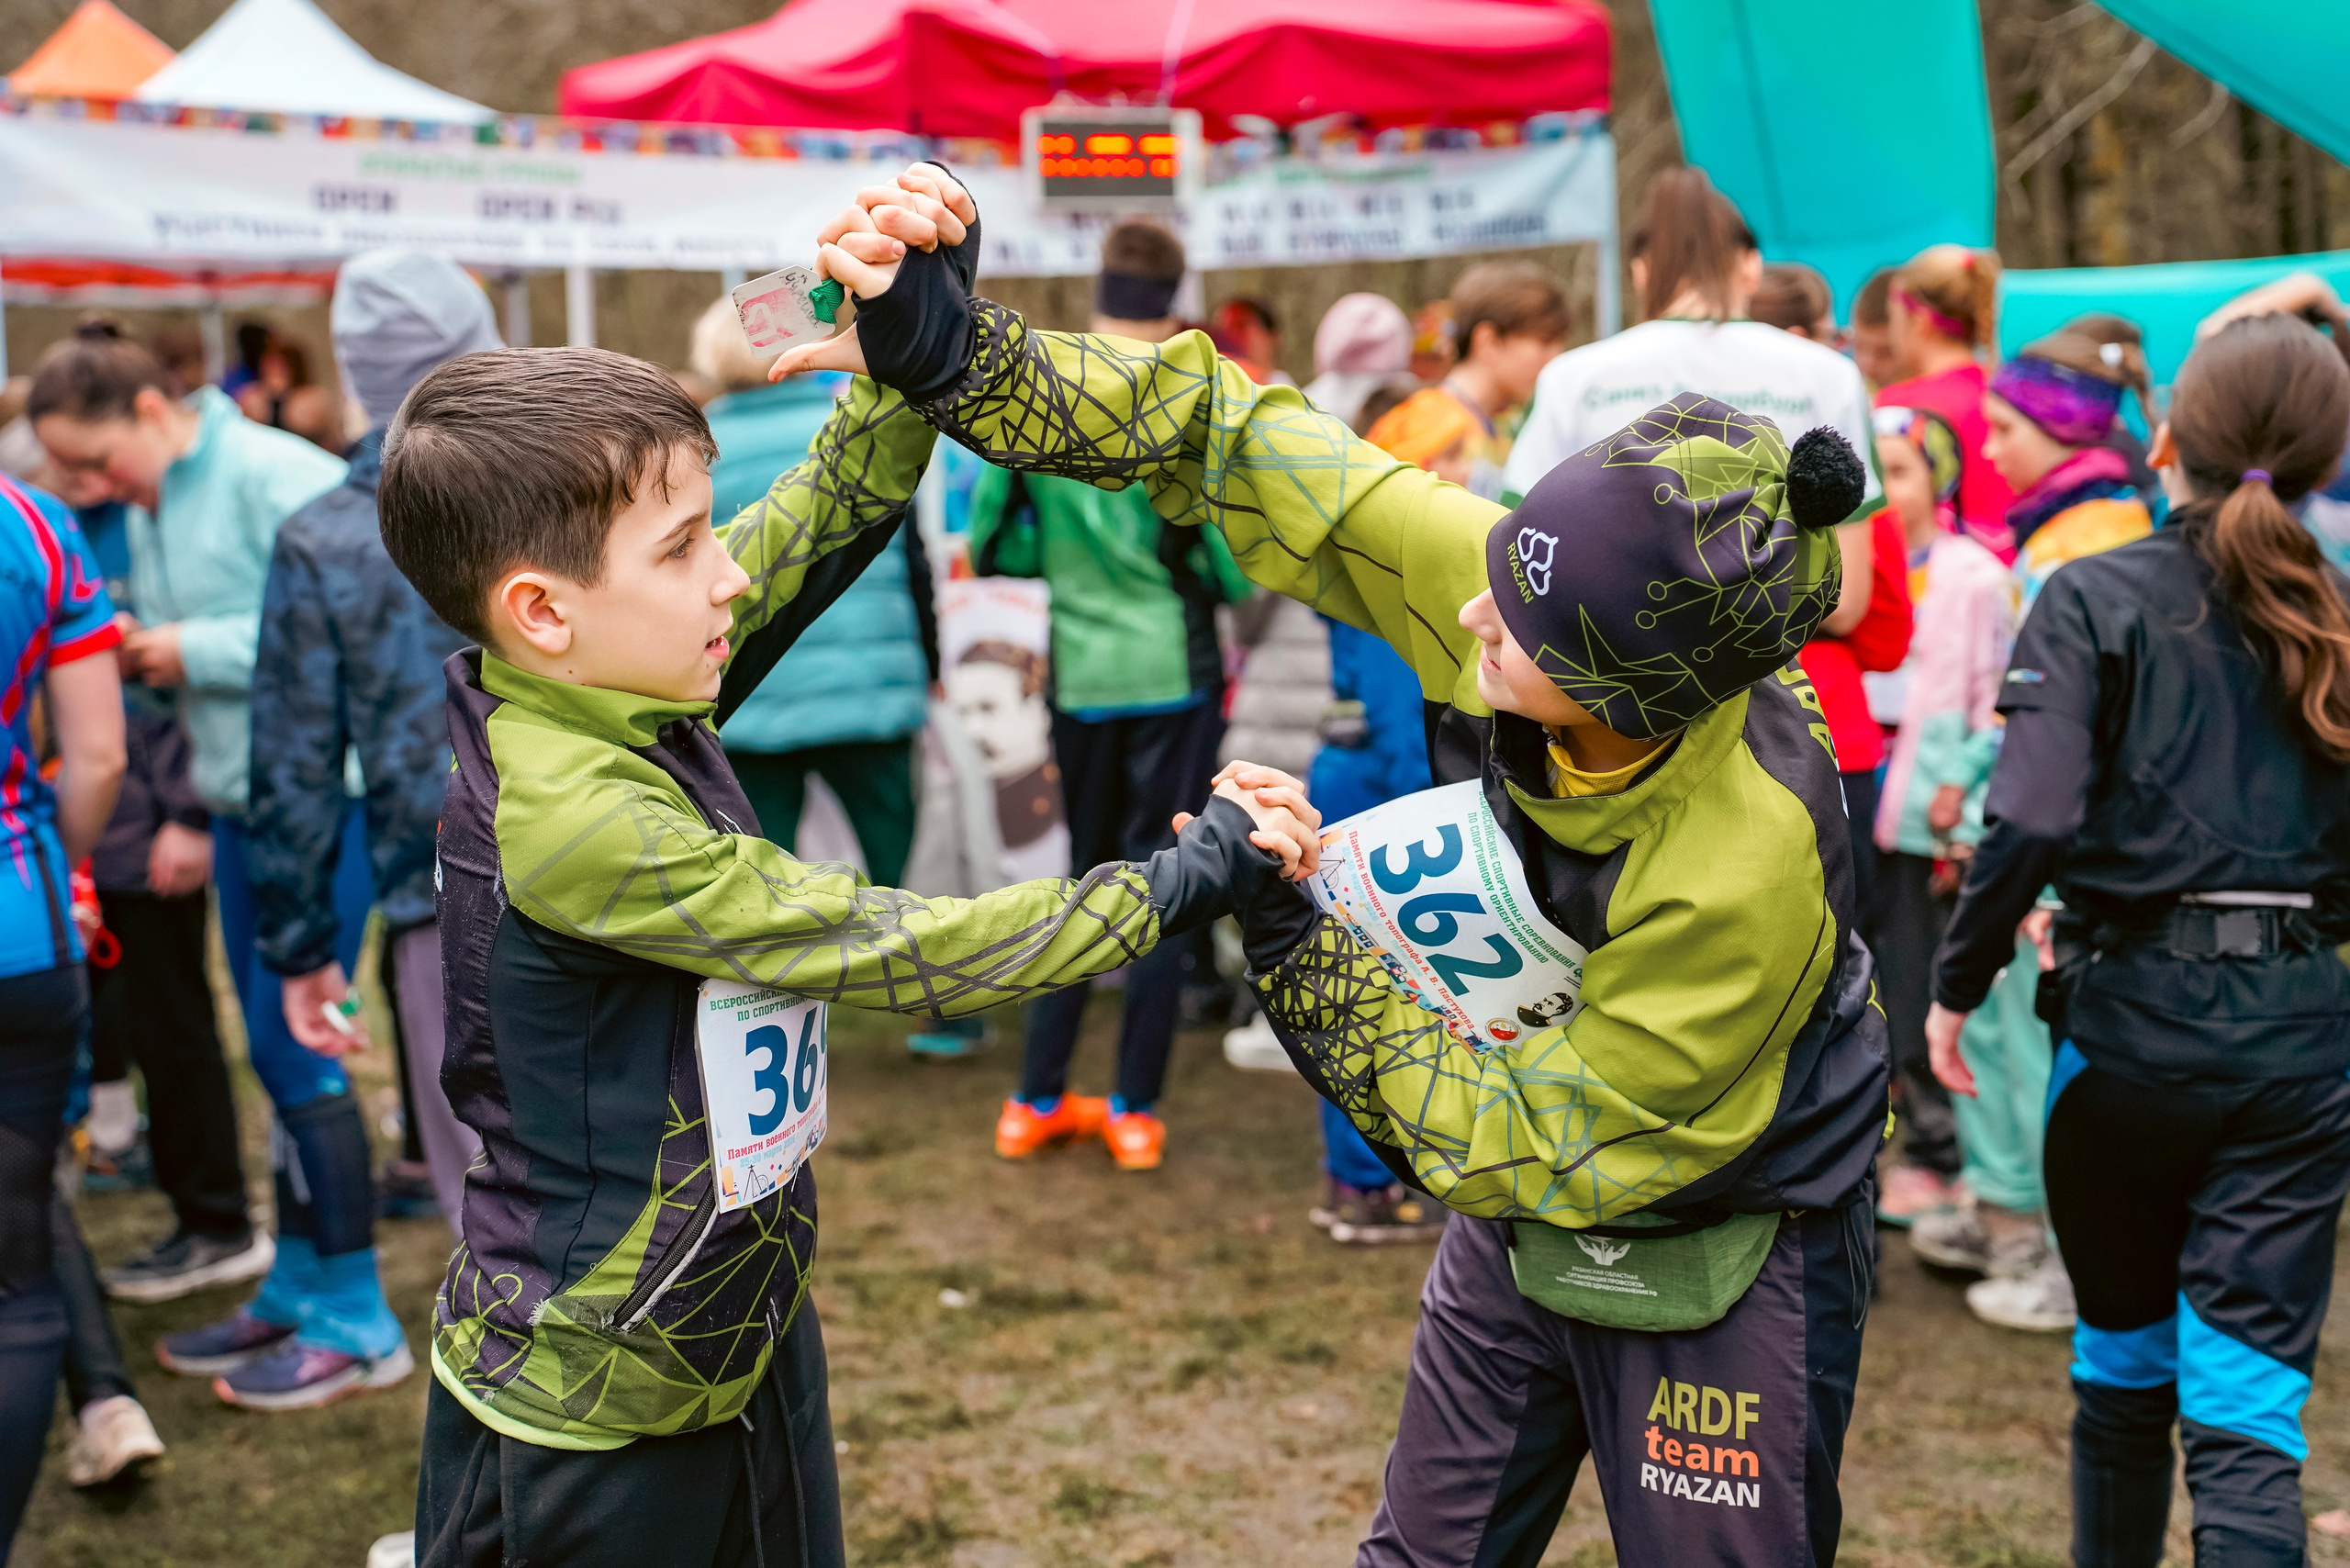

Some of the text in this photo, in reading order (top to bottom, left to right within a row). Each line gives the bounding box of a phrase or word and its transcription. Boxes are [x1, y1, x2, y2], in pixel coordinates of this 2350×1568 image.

[1507, 542, 1534, 604] RYAZAN
[1342, 846, 1355, 870] 25-30
[1351, 872, 1366, 900] марта
[1363, 902, 1379, 922] 2026
[1391, 939, 1423, 977] Пятигорск
[1370, 823, 1524, 997] 362
[1468, 812, 1550, 964] ПО СПОРТИВНОМУ ОРИЕНТИРОВАНИЮ
[1348, 830, 1474, 1029] Памяти военного топографа А. В. Пастухова
[1492, 860, 1525, 924] СПОРТИВНЫЕ
[1521, 924, 1576, 969] СОРЕВНОВАНИЯ
[710, 989, 787, 1011] ВСЕРОССИЙСК
[737, 1010, 750, 1021] ПО
[727, 1141, 763, 1159] Памяти
[766, 1124, 796, 1148] военного
[740, 1153, 761, 1168] 25-30
[764, 1145, 782, 1159] марта
[1555, 1276, 1593, 1288] РАБОТНИКОВ
[1593, 1282, 1649, 1295] ЗДРАВООХРАНЕНИЯ
[1566, 1271, 1645, 1288] ОРГАНИЗАЦИЯ ПРОФСОЮЗА
[1572, 1266, 1639, 1280] РЯЗАНСКАЯ ОБЛАСТНАЯ
[1647, 1375, 1760, 1440] ARDF
[1644, 1426, 1760, 1477] team
[1640, 1462, 1760, 1507] RYAZAN
